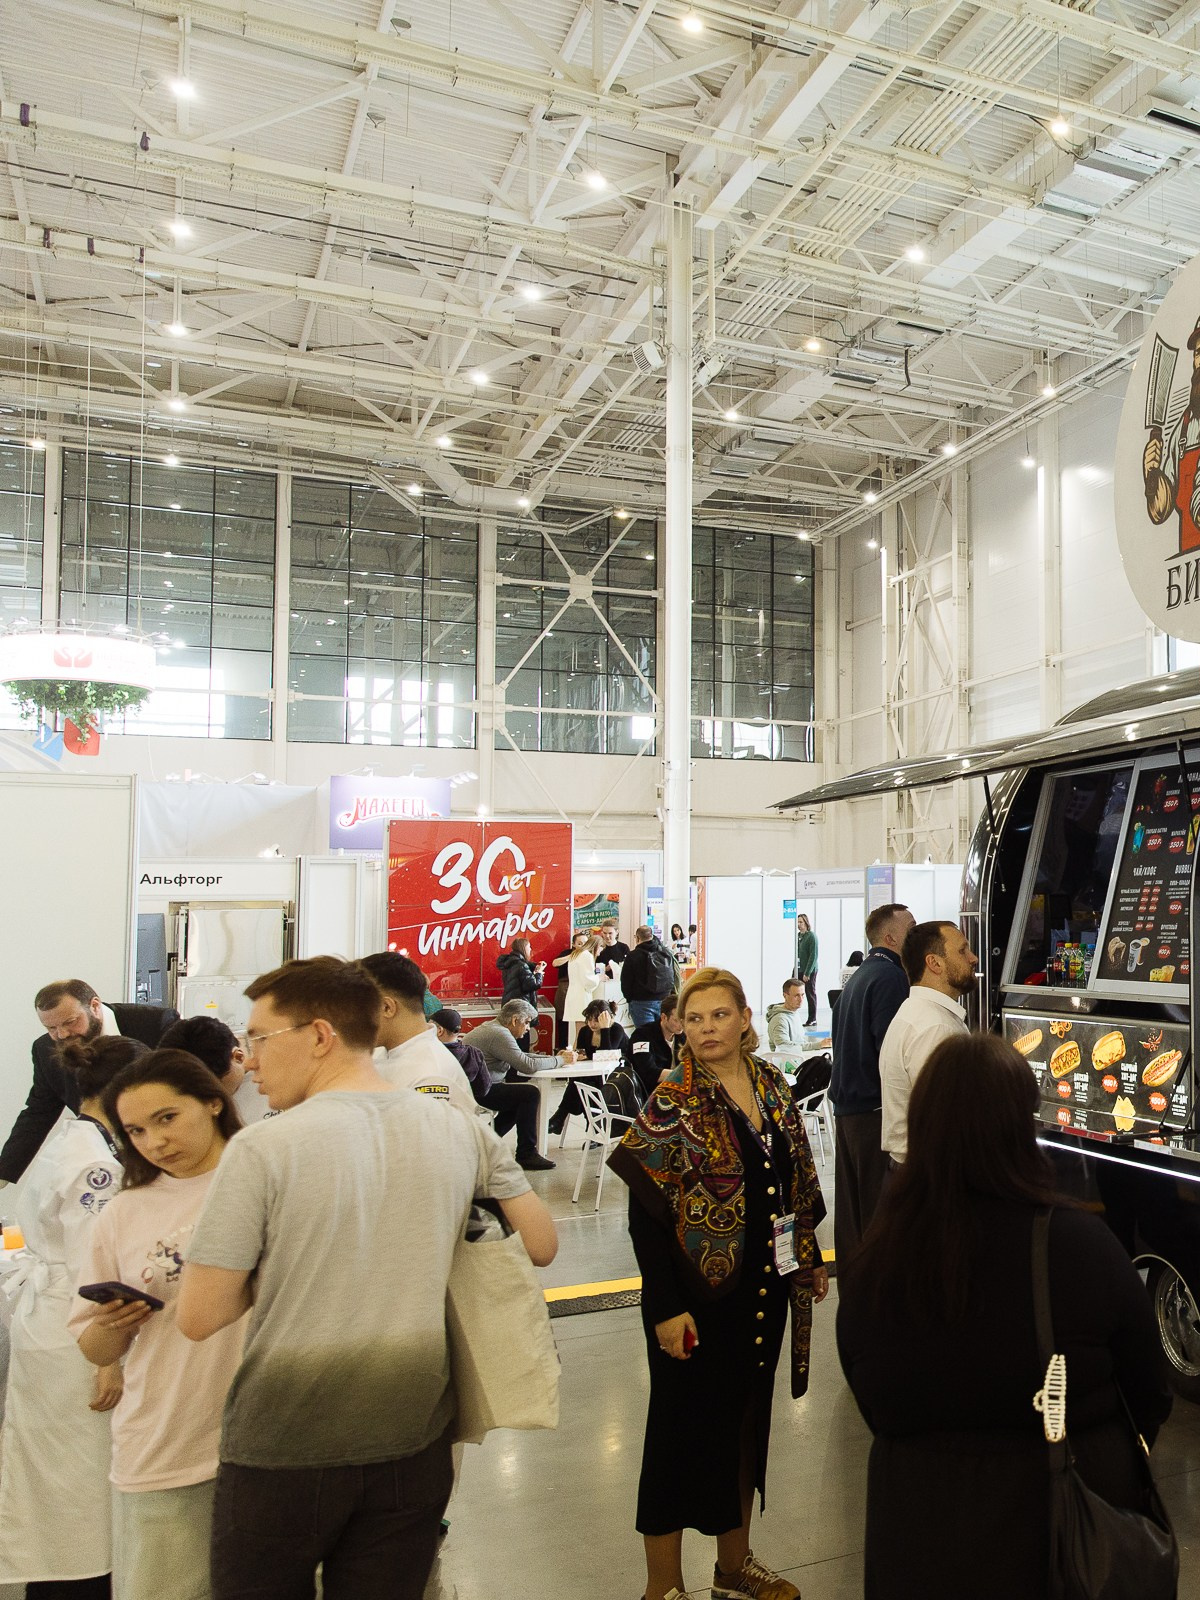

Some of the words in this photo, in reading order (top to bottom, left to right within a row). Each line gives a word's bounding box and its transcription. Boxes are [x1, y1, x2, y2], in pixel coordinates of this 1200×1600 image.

[140, 873, 223, 887] Альфторг
[431, 835, 526, 914] 30
[498, 870, 536, 892] лет
[416, 1085, 448, 1094] METRO
